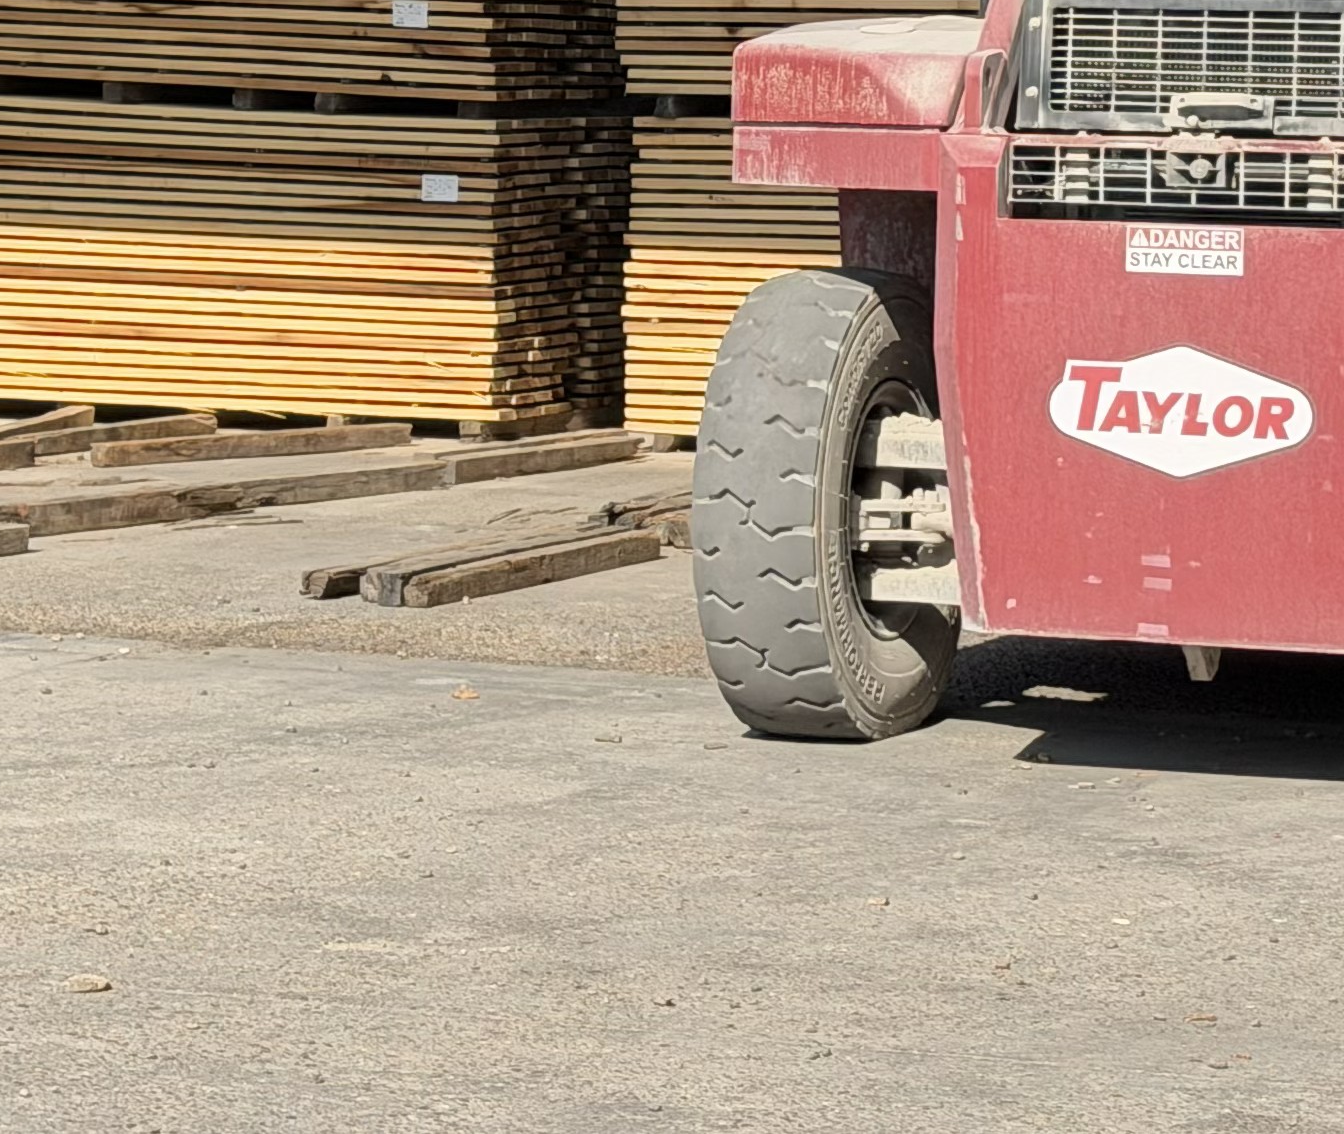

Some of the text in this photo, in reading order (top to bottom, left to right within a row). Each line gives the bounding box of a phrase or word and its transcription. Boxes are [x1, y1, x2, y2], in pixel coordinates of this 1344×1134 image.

[1149, 229, 1240, 250] DANGER
[1130, 252, 1238, 270] STAY CLEAR
[1068, 365, 1295, 440] TAYLOR
